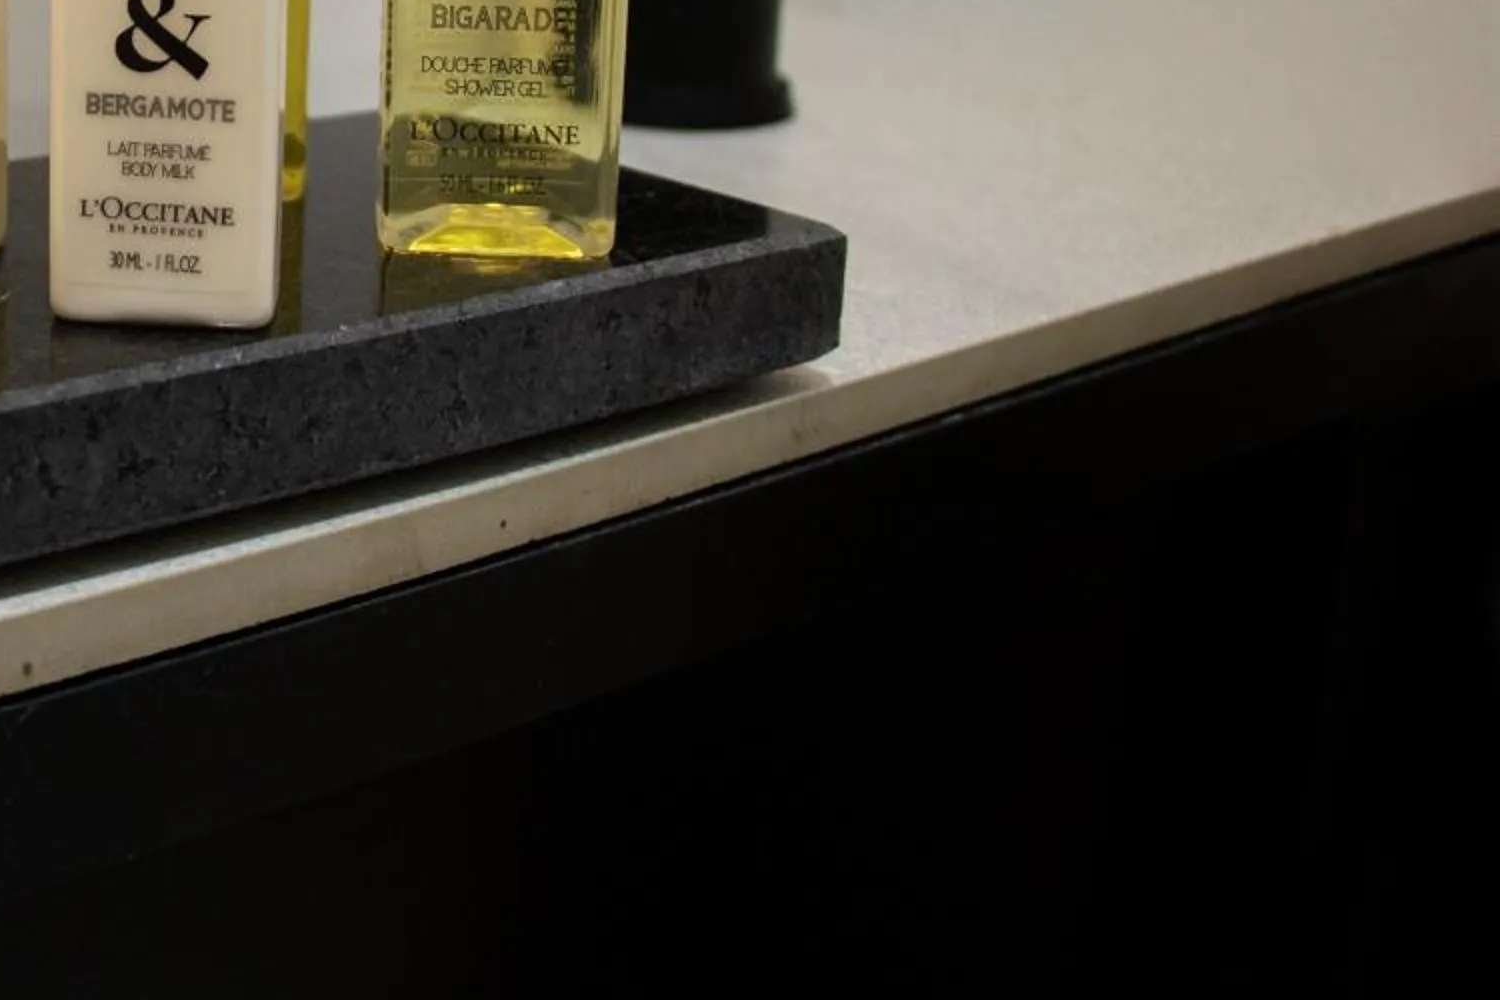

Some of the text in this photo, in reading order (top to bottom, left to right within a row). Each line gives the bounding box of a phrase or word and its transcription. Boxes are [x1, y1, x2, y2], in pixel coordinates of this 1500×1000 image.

[431, 3, 568, 33] BIGARADE
[420, 55, 486, 75] DOUCHE
[444, 78, 548, 98] SHOWER GEL
[85, 92, 237, 123] BERGAMOTE
[107, 140, 140, 158] LAIT
[121, 161, 196, 179] BODY MILK
[80, 196, 236, 226] L'OCCITANE
[133, 224, 204, 238] PROVENCE
